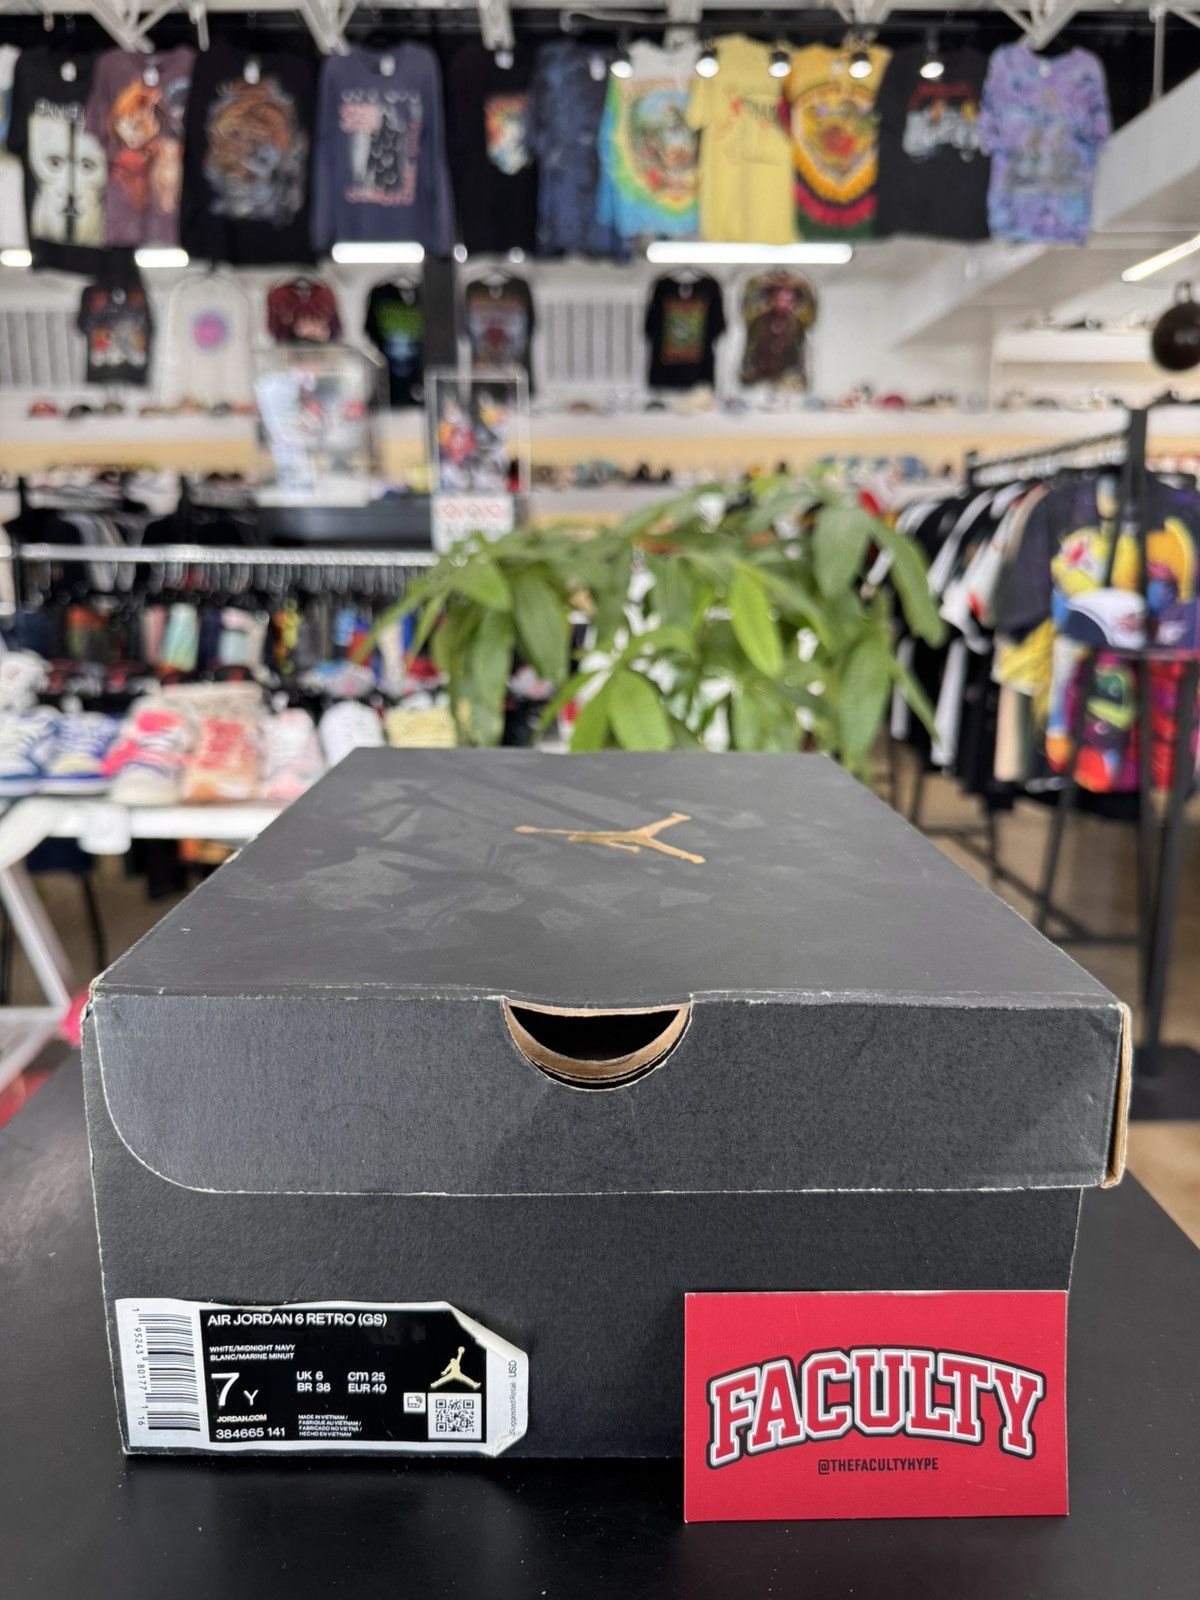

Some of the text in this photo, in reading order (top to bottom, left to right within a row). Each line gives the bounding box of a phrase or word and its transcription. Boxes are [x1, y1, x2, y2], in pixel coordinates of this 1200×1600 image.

[207, 1312, 388, 1328] AIR JORDAN 6 RETRO (GS)
[133, 1327, 144, 1355] 95243
[209, 1344, 296, 1353] WHITE/MIDNIGHT NAVY
[210, 1352, 295, 1361] BLANC/MARINE MINUIT
[508, 1360, 517, 1378] USD
[137, 1363, 148, 1391] 80177
[296, 1371, 324, 1381] UK 6
[371, 1372, 386, 1382] 25
[211, 1372, 259, 1407] 7 Y
[297, 1382, 331, 1393] BR 38
[348, 1383, 387, 1395] EUR 40
[706, 1344, 1046, 1470] FACULTY
[137, 1415, 146, 1426] 16
[217, 1414, 267, 1423] JORDAN.COM
[216, 1427, 286, 1439] 384665 141
[818, 1458, 939, 1475] @THEFACULTYHYPE
